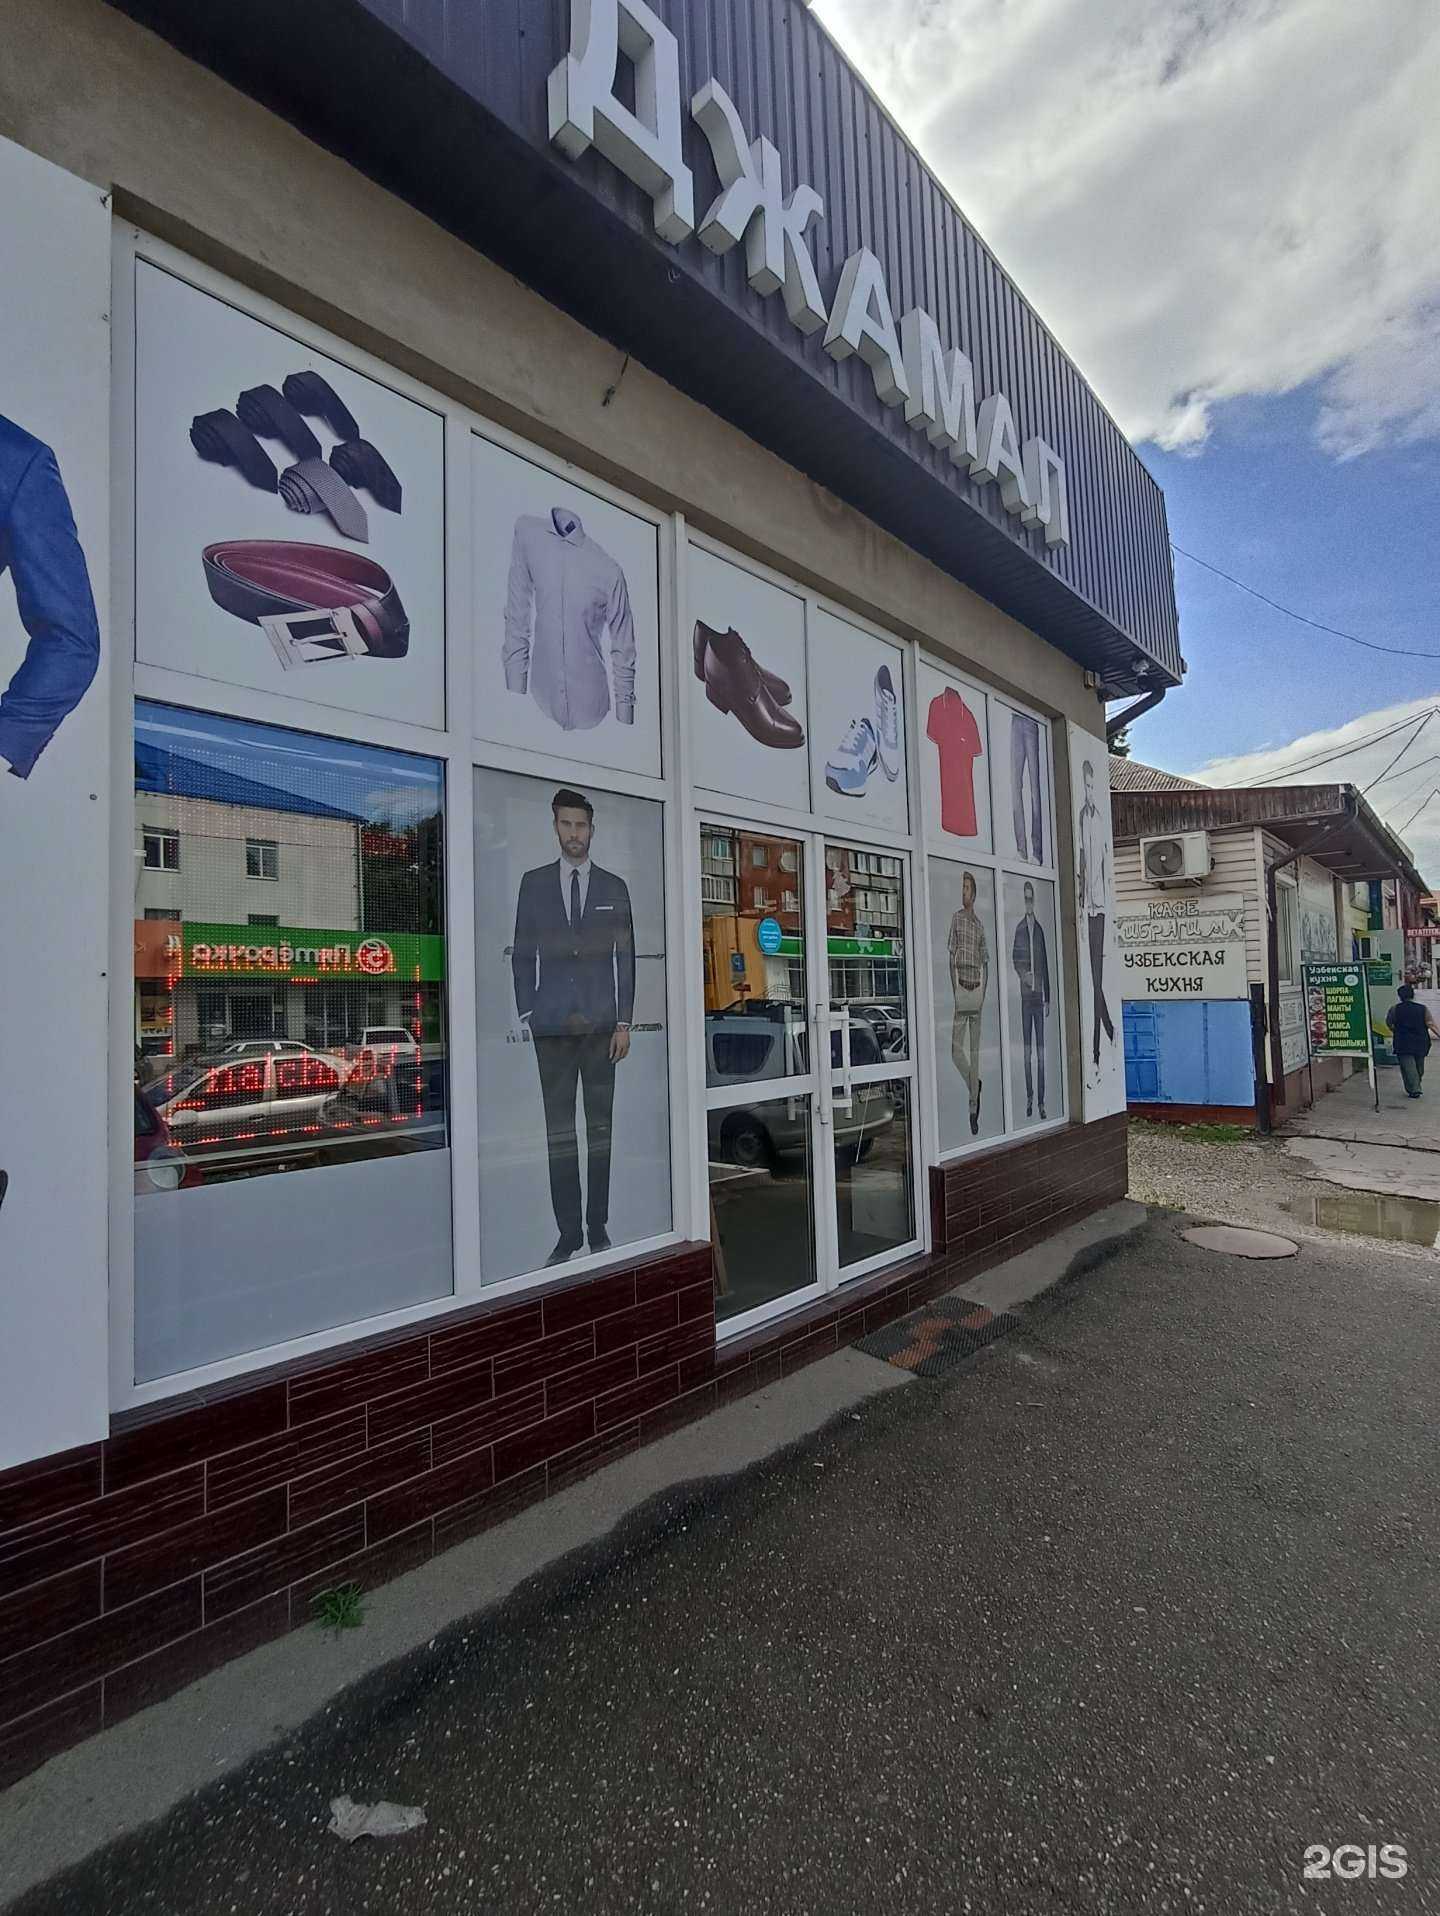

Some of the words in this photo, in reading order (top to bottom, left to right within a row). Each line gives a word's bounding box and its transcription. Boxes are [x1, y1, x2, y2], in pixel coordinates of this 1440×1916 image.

[548, 0, 1069, 551] ДЖАМАЛ
[1148, 900, 1199, 920] КАФЕ
[1124, 950, 1225, 968] УЗБЕКСКАЯ
[1309, 966, 1359, 974] Узбекская
[1309, 975, 1338, 985] кухня
[1145, 977, 1203, 992] КУХНЯ
[1326, 987, 1349, 995] ШОРПА
[1326, 995, 1354, 1003] ЛАГМАН
[1327, 1004, 1352, 1012] МАНТЫ
[1327, 1013, 1346, 1021] ПЛОВ
[1328, 1021, 1350, 1030] САМСА
[1329, 1030, 1349, 1038] ЛЮЛЯ
[1329, 1039, 1366, 1047] ШАШЛЫКИ
